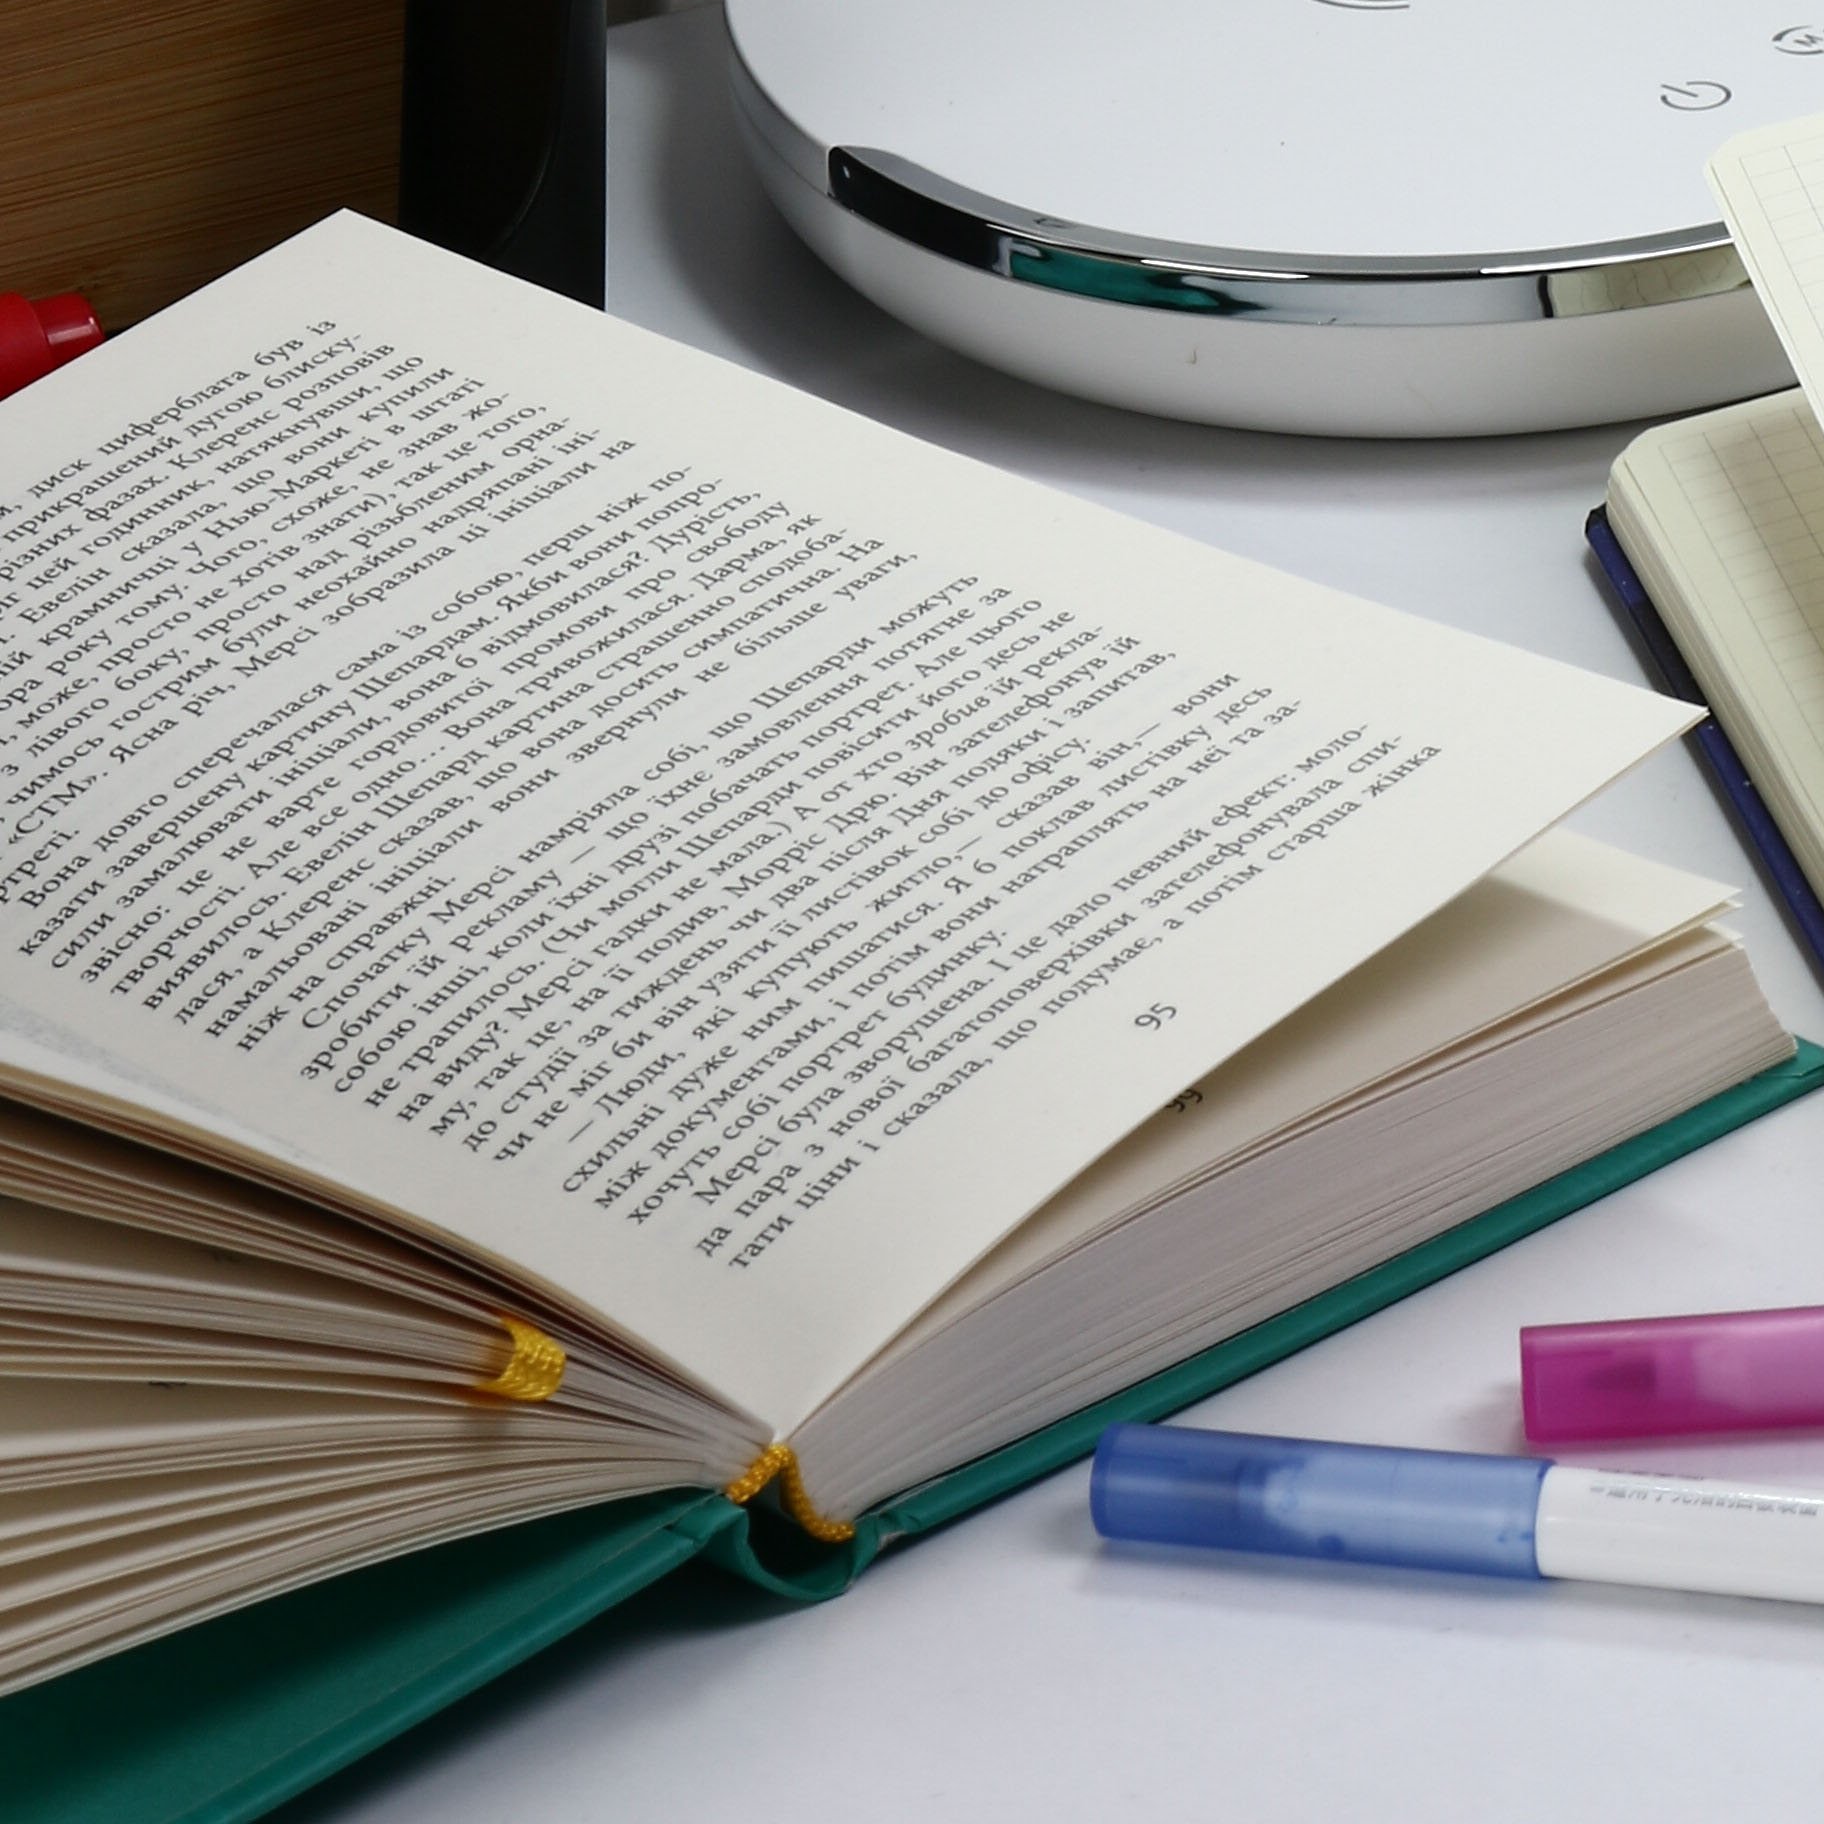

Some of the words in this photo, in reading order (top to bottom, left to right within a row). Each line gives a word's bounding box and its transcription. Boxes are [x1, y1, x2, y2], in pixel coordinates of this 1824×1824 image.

[15, 565, 112, 625] Евелін
[118, 500, 229, 563] сказала,
[230, 467, 276, 495] що
[282, 424, 352, 466] вони
[356, 366, 455, 423] купили
[25, 457, 92, 500] диск
[96, 369, 252, 457] циферблата
[252, 337, 305, 367] був
[304, 319, 337, 337] із
[35, 553, 180, 648] крамничці
[200, 434, 382, 540] Нью-Маркеті
[408, 376, 485, 422] штаті
[107, 717, 180, 765] Ясна
[179, 682, 237, 719] річ,
[230, 624, 320, 679] Мерсі
[320, 544, 457, 626] зобразила
[456, 521, 491, 544] ці
[485, 459, 598, 524] ініціали
[598, 438, 637, 461] на
[16, 853, 93, 910] Вона
[91, 792, 169, 854] довго
[171, 681, 333, 790] сперечалася
[333, 640, 400, 682] сама
[394, 622, 428, 641] із
[429, 569, 524, 623] собою,
[520, 522, 596, 567] перш
[594, 491, 649, 524] ніж
[647, 465, 691, 493] по-
[16, 878, 108, 957] казати
[103, 770, 247, 879] завершену
[243, 697, 357, 773] картину
[348, 614, 500, 701] Шепардам.
[494, 568, 569, 614] Якби
[566, 528, 636, 571] вони
[634, 477, 722, 532] попро-
[49, 910, 116, 970] сили
[114, 787, 273, 910] замалювати
[267, 714, 393, 788] ініціали,
[388, 669, 458, 712] вона
[479, 549, 650, 657] відмовилася?
[646, 491, 762, 555] Дурість,
[78, 903, 171, 984] звісно:
[175, 867, 214, 897] це
[219, 834, 258, 862] не
[262, 775, 342, 830] варте
[347, 675, 494, 771] гордовитої
[499, 603, 618, 676] промови
[622, 567, 677, 601] про
[685, 499, 791, 564] свободу
[140, 889, 288, 1011] виявилось.
[279, 819, 379, 886] Евелін
[370, 748, 490, 820] Шепард
[483, 680, 596, 750] картина
[594, 594, 736, 681] страшенно
[737, 528, 847, 595] сподоба-
[172, 966, 245, 1026] лася,
[256, 856, 376, 942] Клеренс
[376, 793, 475, 856] сказав,
[471, 760, 519, 791] що
[518, 717, 588, 760] вона
[587, 660, 680, 720] досить
[681, 566, 842, 659] симпатична.
[835, 537, 885, 563] На
[202, 897, 369, 1039] намальовані
[367, 817, 484, 895] ініціали
[488, 766, 560, 814] вони
[564, 685, 689, 764] звернули
[692, 659, 730, 684] не
[732, 601, 828, 657] більше
[831, 552, 919, 602] уваги,
[300, 925, 432, 1030] Спочатку
[425, 863, 517, 925] Мерсі
[516, 783, 641, 865] намріяла
[641, 742, 710, 782] собі,
[707, 710, 753, 740] що
[749, 635, 877, 710] Шепарди
[877, 575, 979, 636] можуть
[332, 1017, 418, 1094] собою
[410, 963, 490, 1016] інші,
[484, 910, 556, 961] коли
[546, 870, 610, 911] їхні
[608, 822, 682, 876] друзі
[678, 749, 801, 826] побачать
[798, 680, 915, 749] портрет.
[913, 644, 967, 679] Але
[965, 598, 1043, 646] цього
[427, 1098, 478, 1138] му,
[472, 1050, 527, 1091] так
[524, 1018, 573, 1049] це,
[569, 985, 610, 1013] на
[601, 961, 635, 984] її
[633, 903, 730, 965] подив,
[720, 832, 827, 900] Морріс
[822, 791, 898, 835] Дрю.
[891, 756, 948, 788] Він
[946, 655, 1109, 754] зателефонував
[1105, 634, 1141, 656] їй
[561, 1101, 666, 1194] схильні
[666, 1043, 739, 1103] дуже
[739, 995, 802, 1042] ним
[802, 900, 944, 994] пишатися.
[1000, 798, 1096, 860] поклав
[1098, 723, 1213, 798] листівку
[1213, 686, 1273, 726] десь
[691, 1133, 782, 1206] Мерсі
[775, 1085, 846, 1134] була
[841, 976, 995, 1084] зворушена.
[1009, 934, 1048, 960] це
[1047, 892, 1112, 938] дало
[1110, 827, 1211, 892] певний
[1209, 772, 1297, 827] ефект:
[1294, 724, 1367, 774] моло-
[694, 1224, 733, 1258] да
[732, 1162, 803, 1219] пара
[826, 1073, 907, 1138] нової
[904, 911, 1138, 1073] багатоповерхівки
[1139, 777, 1343, 907] зателефонувала
[1346, 736, 1400, 774] спи-
[726, 1213, 795, 1269] тати
[793, 1155, 862, 1211] ціни
[881, 1056, 994, 1137] сказала,
[991, 1017, 1038, 1051] що
[1039, 935, 1163, 1016] подумає,
[1184, 862, 1264, 915] потім
[1265, 799, 1362, 862] старша
[1367, 744, 1442, 798] жінка
[1133, 1002, 1178, 1032] 95
